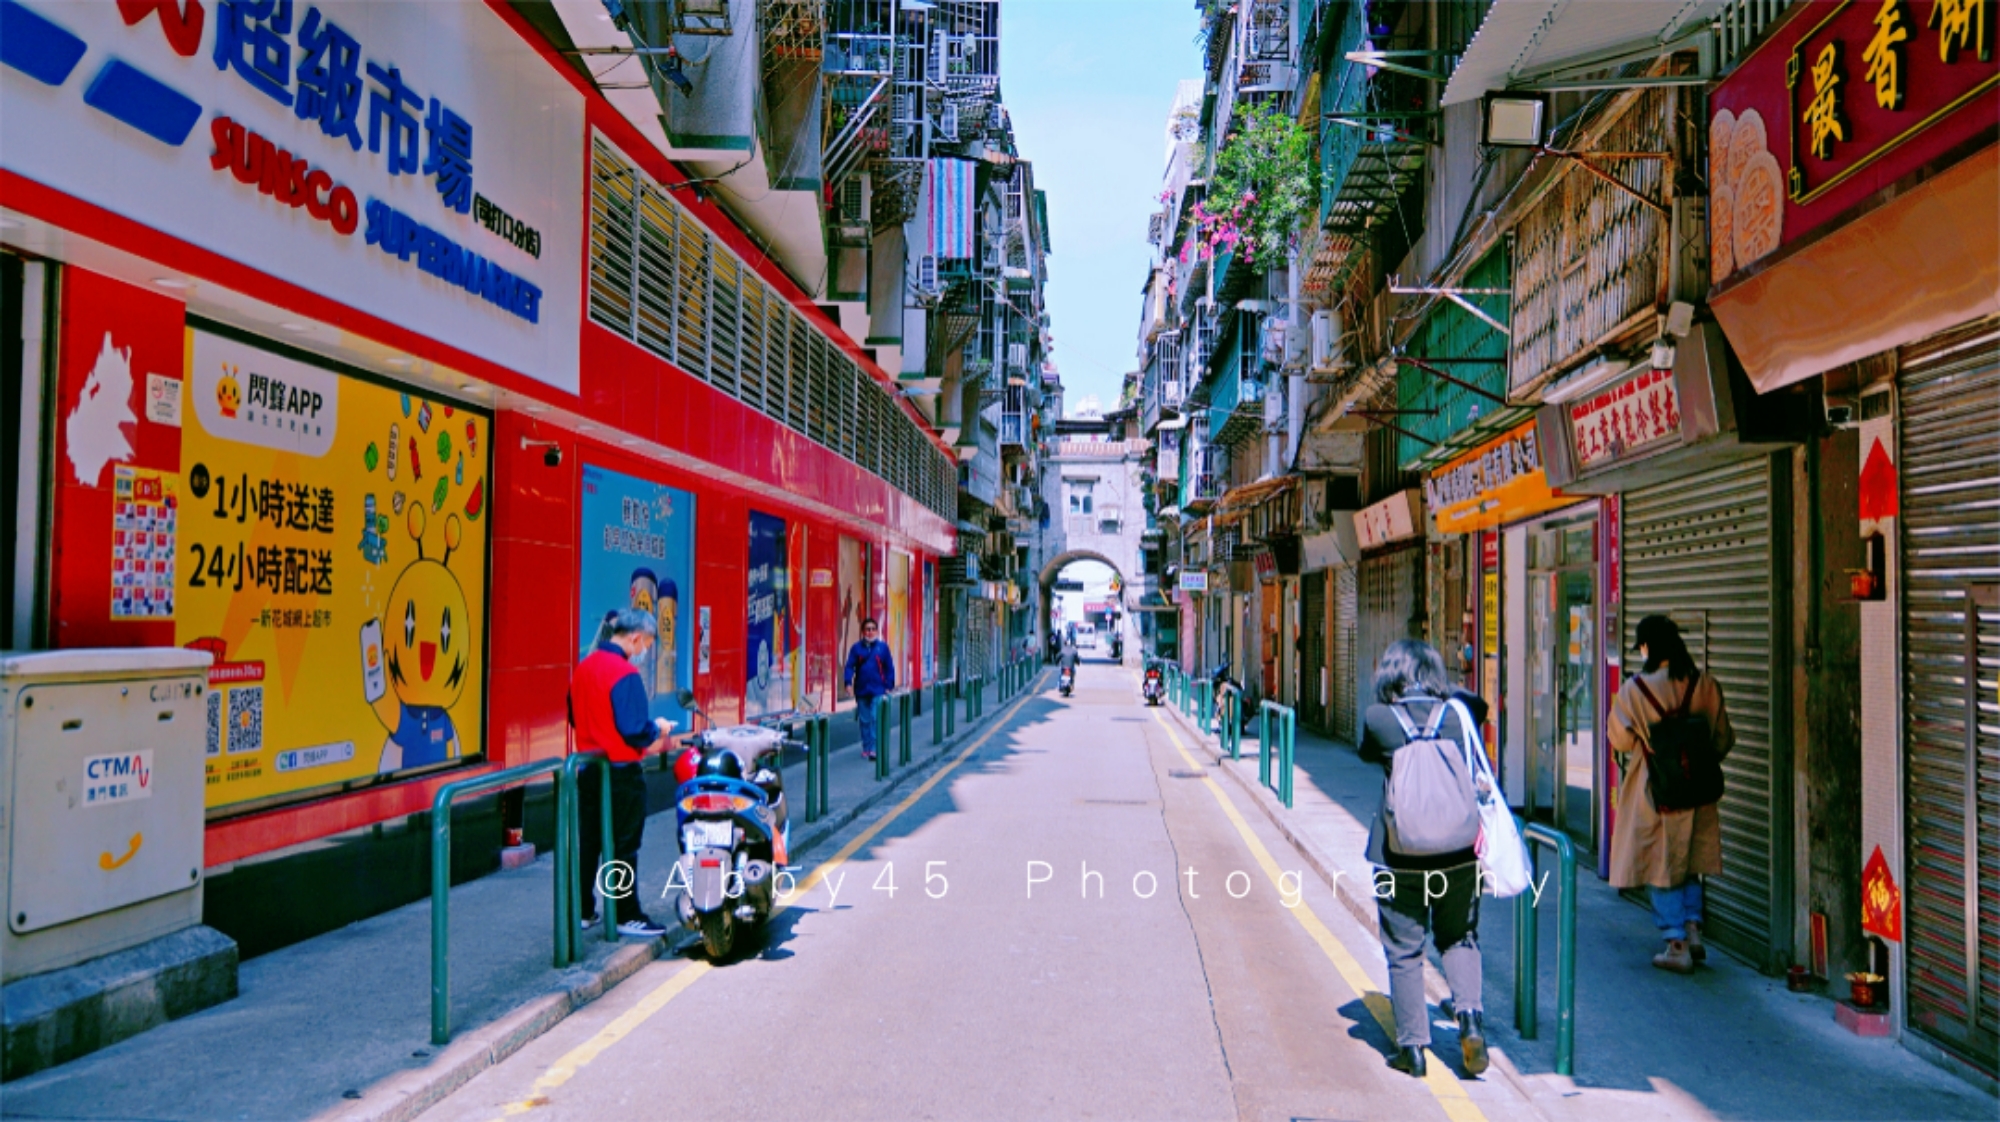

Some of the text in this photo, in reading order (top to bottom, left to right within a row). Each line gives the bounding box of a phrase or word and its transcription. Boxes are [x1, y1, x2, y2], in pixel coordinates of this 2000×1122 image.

[213, 0, 473, 215] 超級市場
[209, 115, 543, 325] SUNSCO SUPERMARKET
[247, 371, 324, 420] 閃蜂APP
[212, 472, 334, 534] 1小時送達
[188, 540, 333, 596] 24小時配送
[87, 755, 131, 779] CTM
